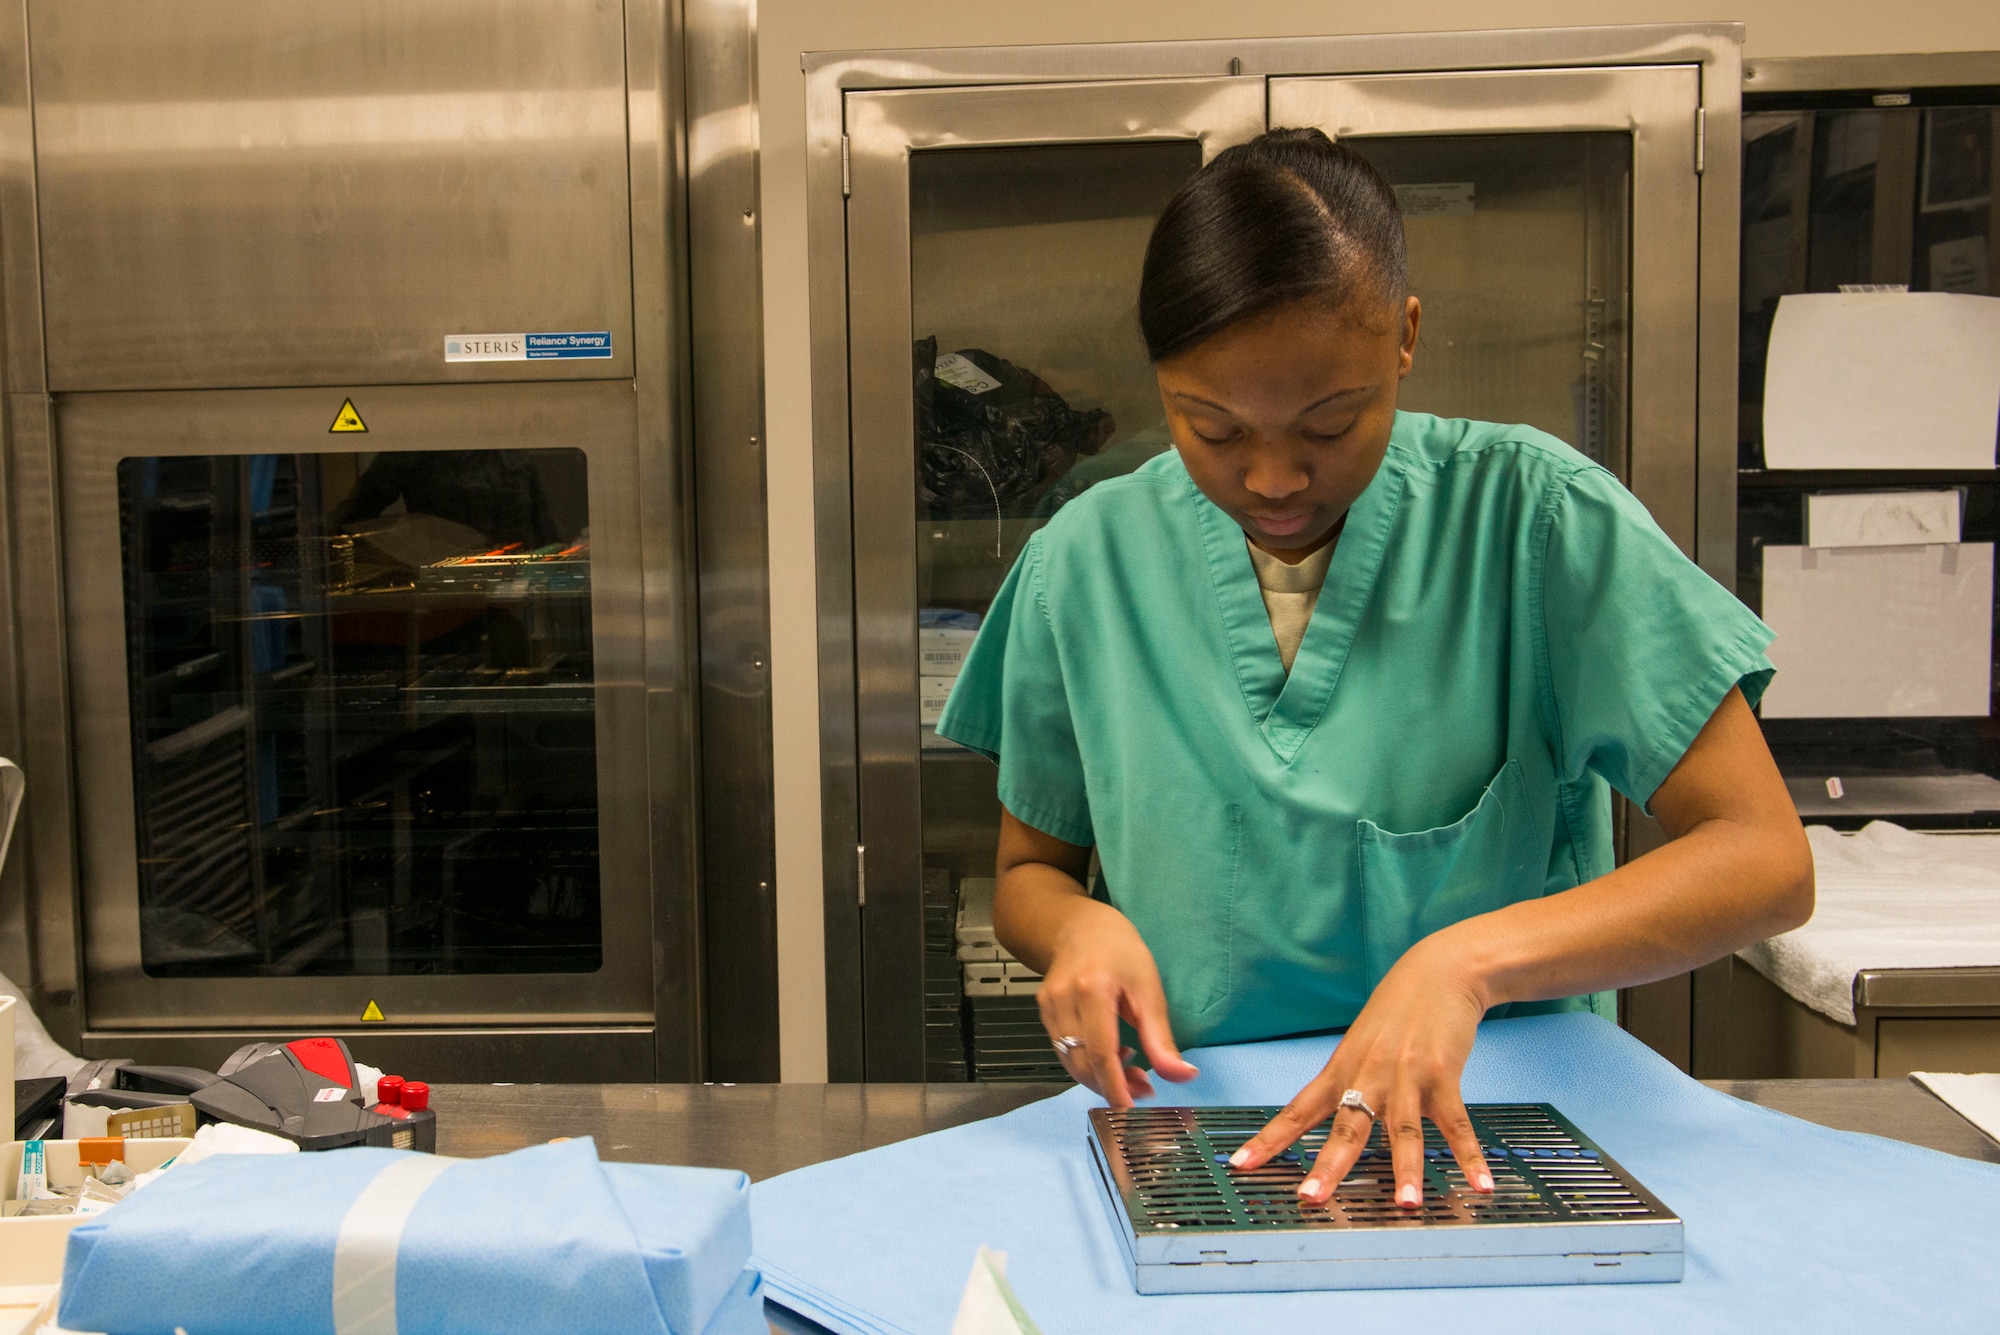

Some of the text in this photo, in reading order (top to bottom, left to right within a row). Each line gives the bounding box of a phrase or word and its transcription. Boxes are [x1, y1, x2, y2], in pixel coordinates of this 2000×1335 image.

[529, 335, 605, 347] Reliance Synergy
[464, 341, 519, 354] STERIS
